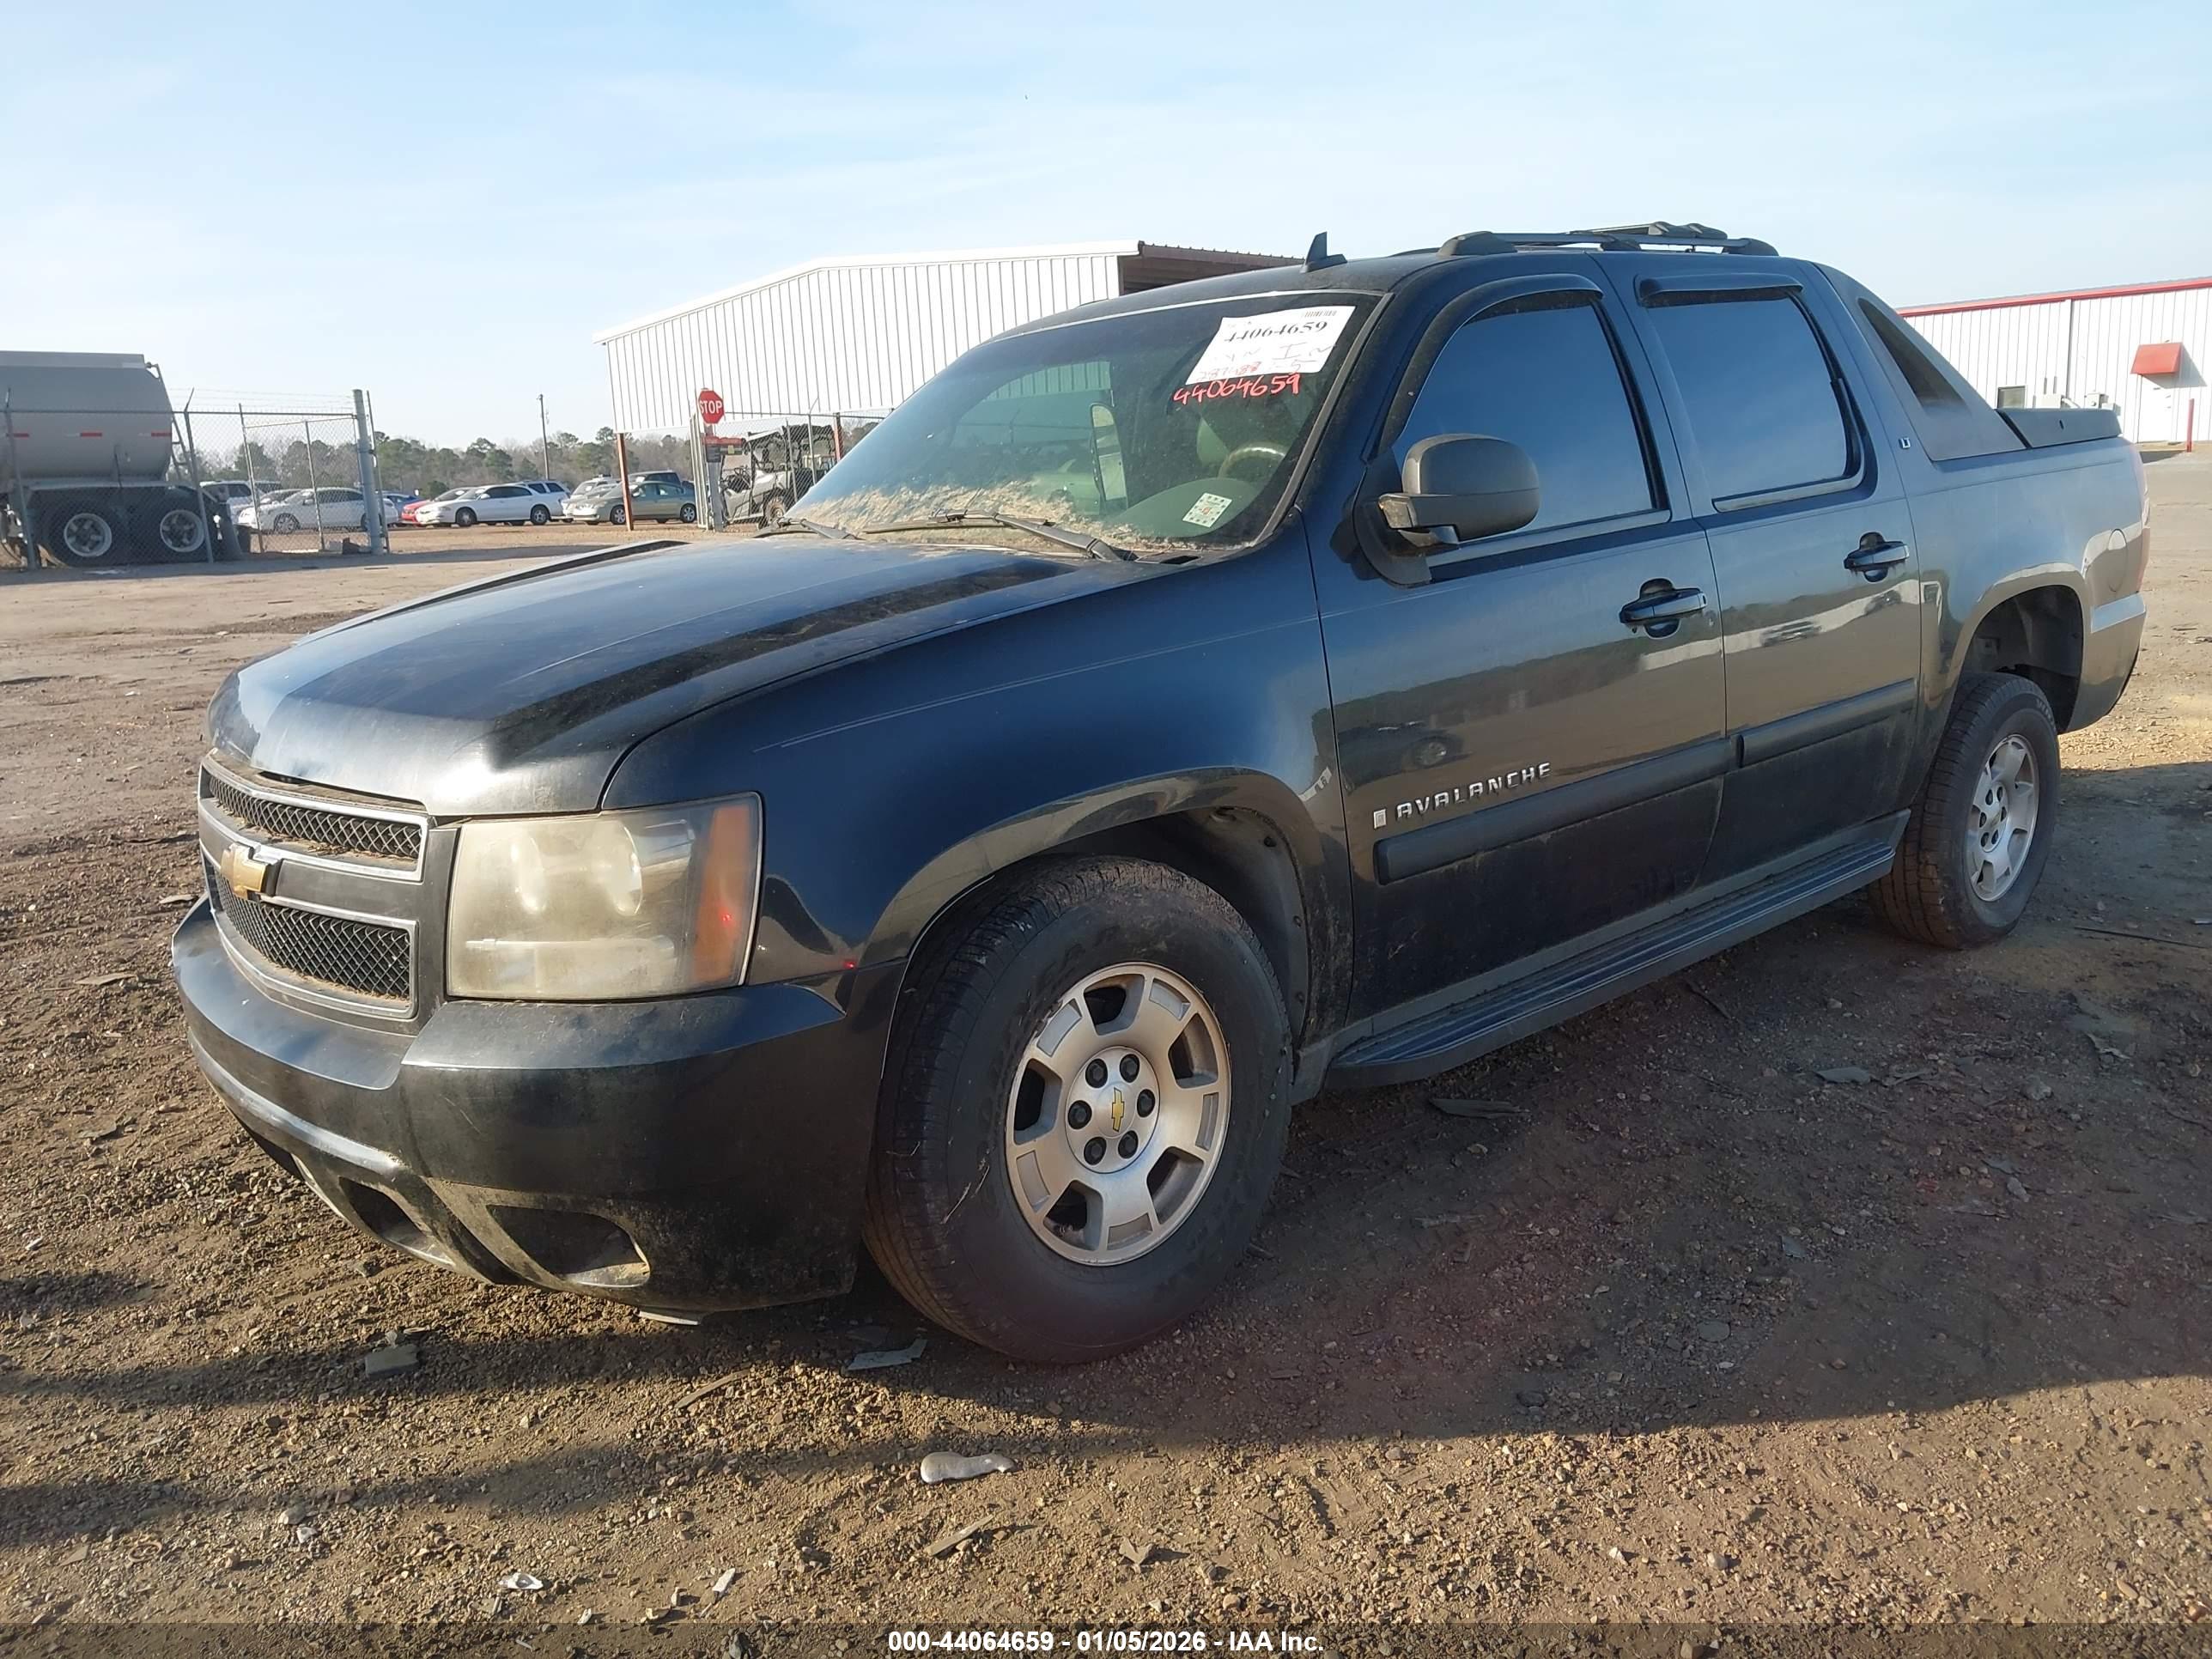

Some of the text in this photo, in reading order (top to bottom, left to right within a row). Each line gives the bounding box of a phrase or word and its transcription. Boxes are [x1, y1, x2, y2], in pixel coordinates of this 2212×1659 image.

[1224, 320, 1328, 342] 44064659
[1173, 373, 1301, 404] 44064659
[700, 400, 722, 414] STOP
[1397, 762, 1552, 818] AVALANCHE
